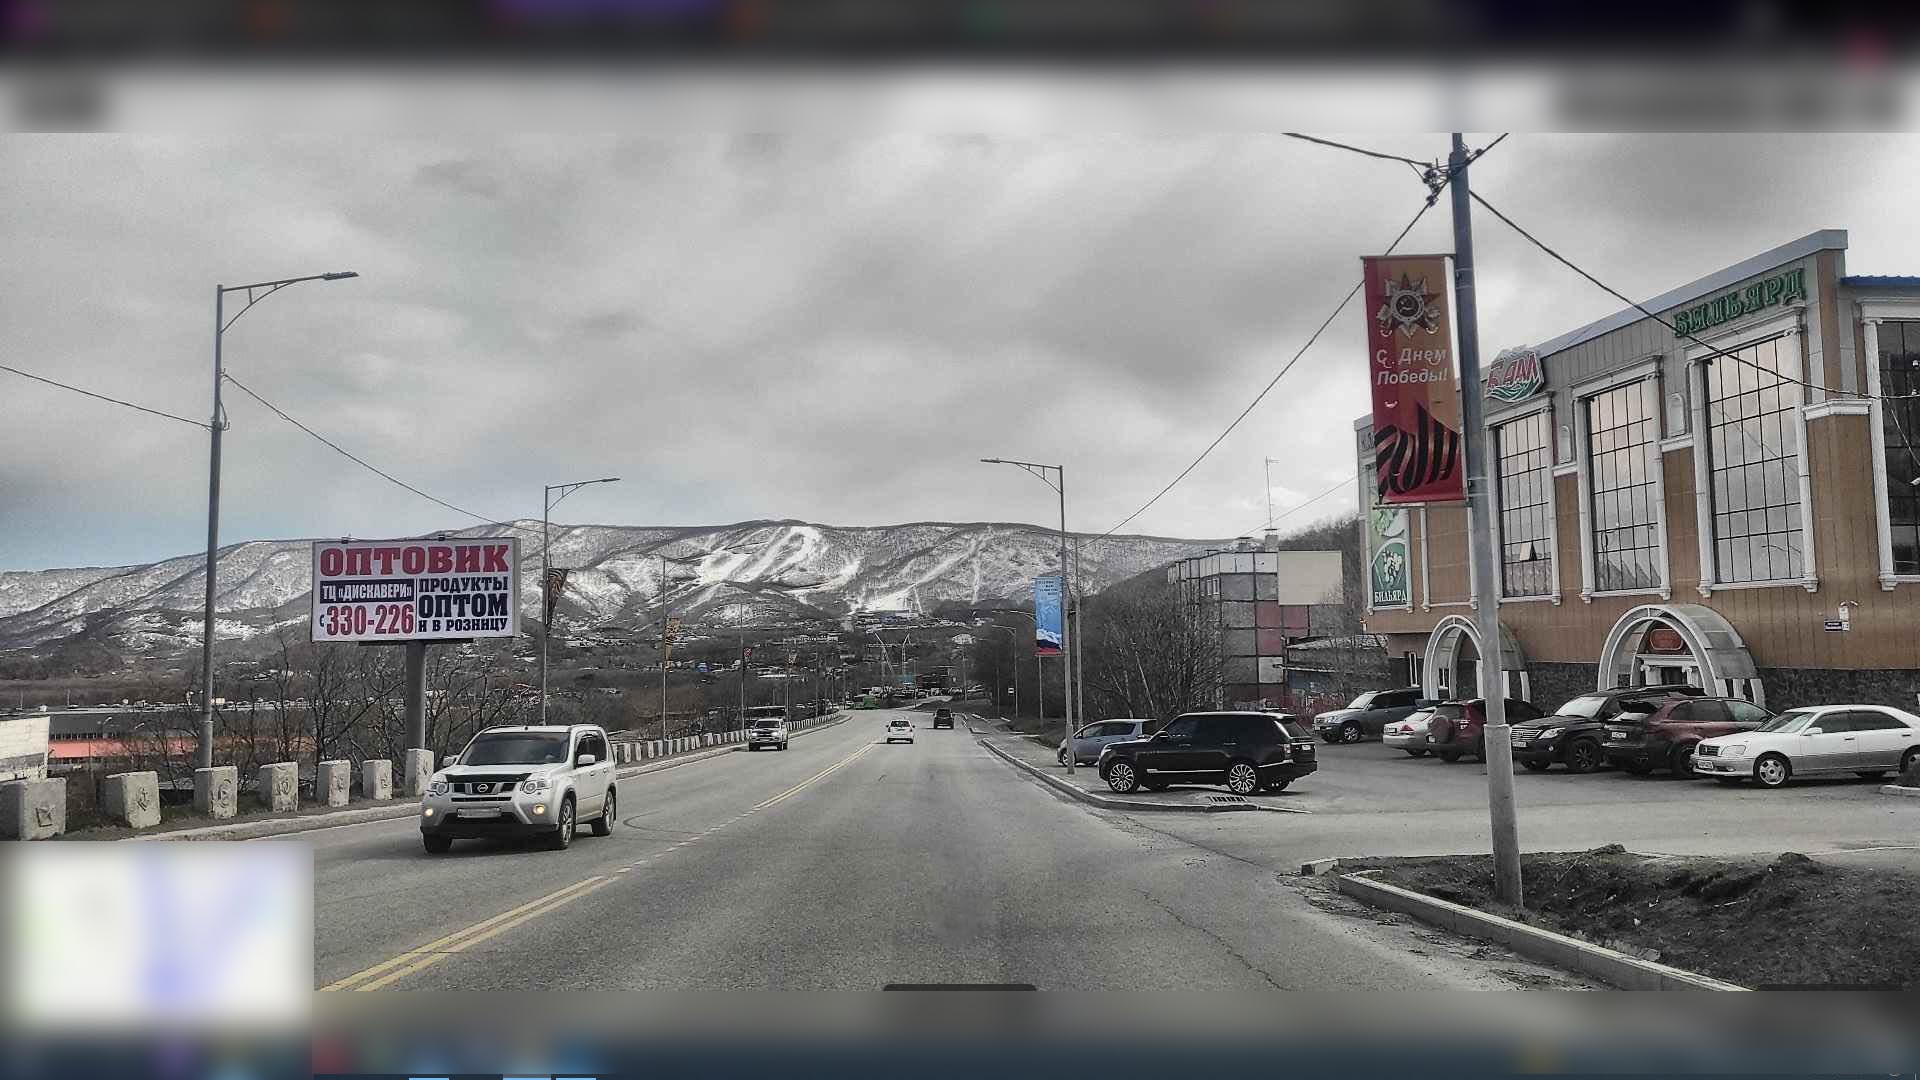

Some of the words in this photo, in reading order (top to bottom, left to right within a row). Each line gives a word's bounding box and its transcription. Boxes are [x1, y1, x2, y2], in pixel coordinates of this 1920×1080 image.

[1673, 271, 1805, 338] БИЛЬЯРД
[1399, 348, 1447, 364] Днем
[1378, 367, 1448, 385] Победы!
[320, 545, 509, 576] ОПТОВИК
[323, 585, 337, 601] ТЦ
[419, 576, 508, 593] ПРОДУКТЫ
[1374, 589, 1407, 603] БИЛЬЯРД
[419, 593, 508, 618] ОПТОМ
[327, 604, 414, 635] 330-226
[432, 620, 441, 632] В
[446, 618, 508, 631] РОЗНИЦУ
